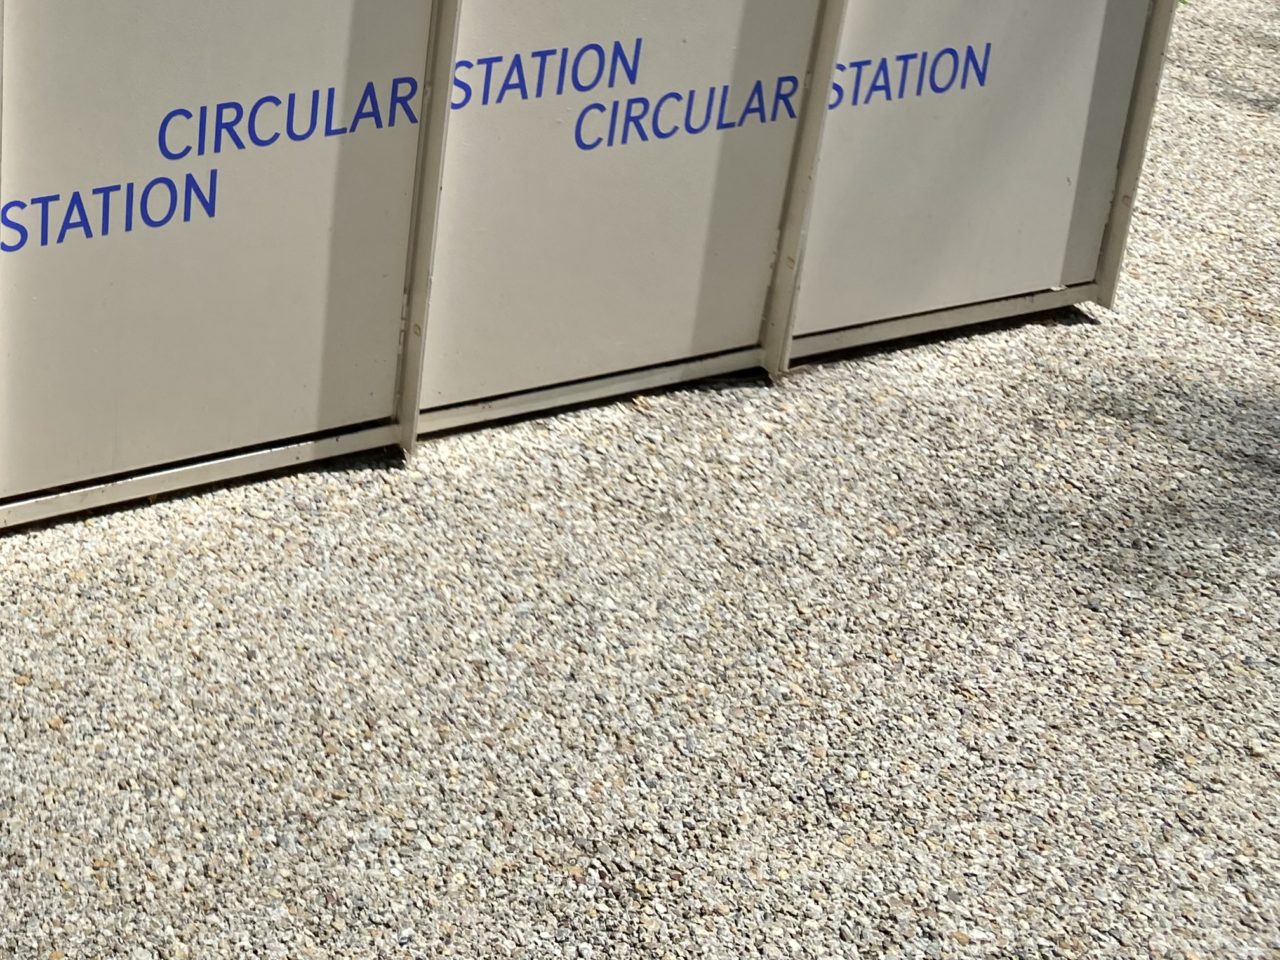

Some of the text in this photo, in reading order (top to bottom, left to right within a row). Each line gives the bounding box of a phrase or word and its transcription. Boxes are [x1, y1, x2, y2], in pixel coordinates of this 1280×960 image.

[449, 37, 644, 111] STATION
[575, 74, 798, 152] CIRCULAR
[828, 43, 993, 110] STATION
[158, 77, 419, 160] CIRCULAR
[0, 168, 218, 253] STATION
